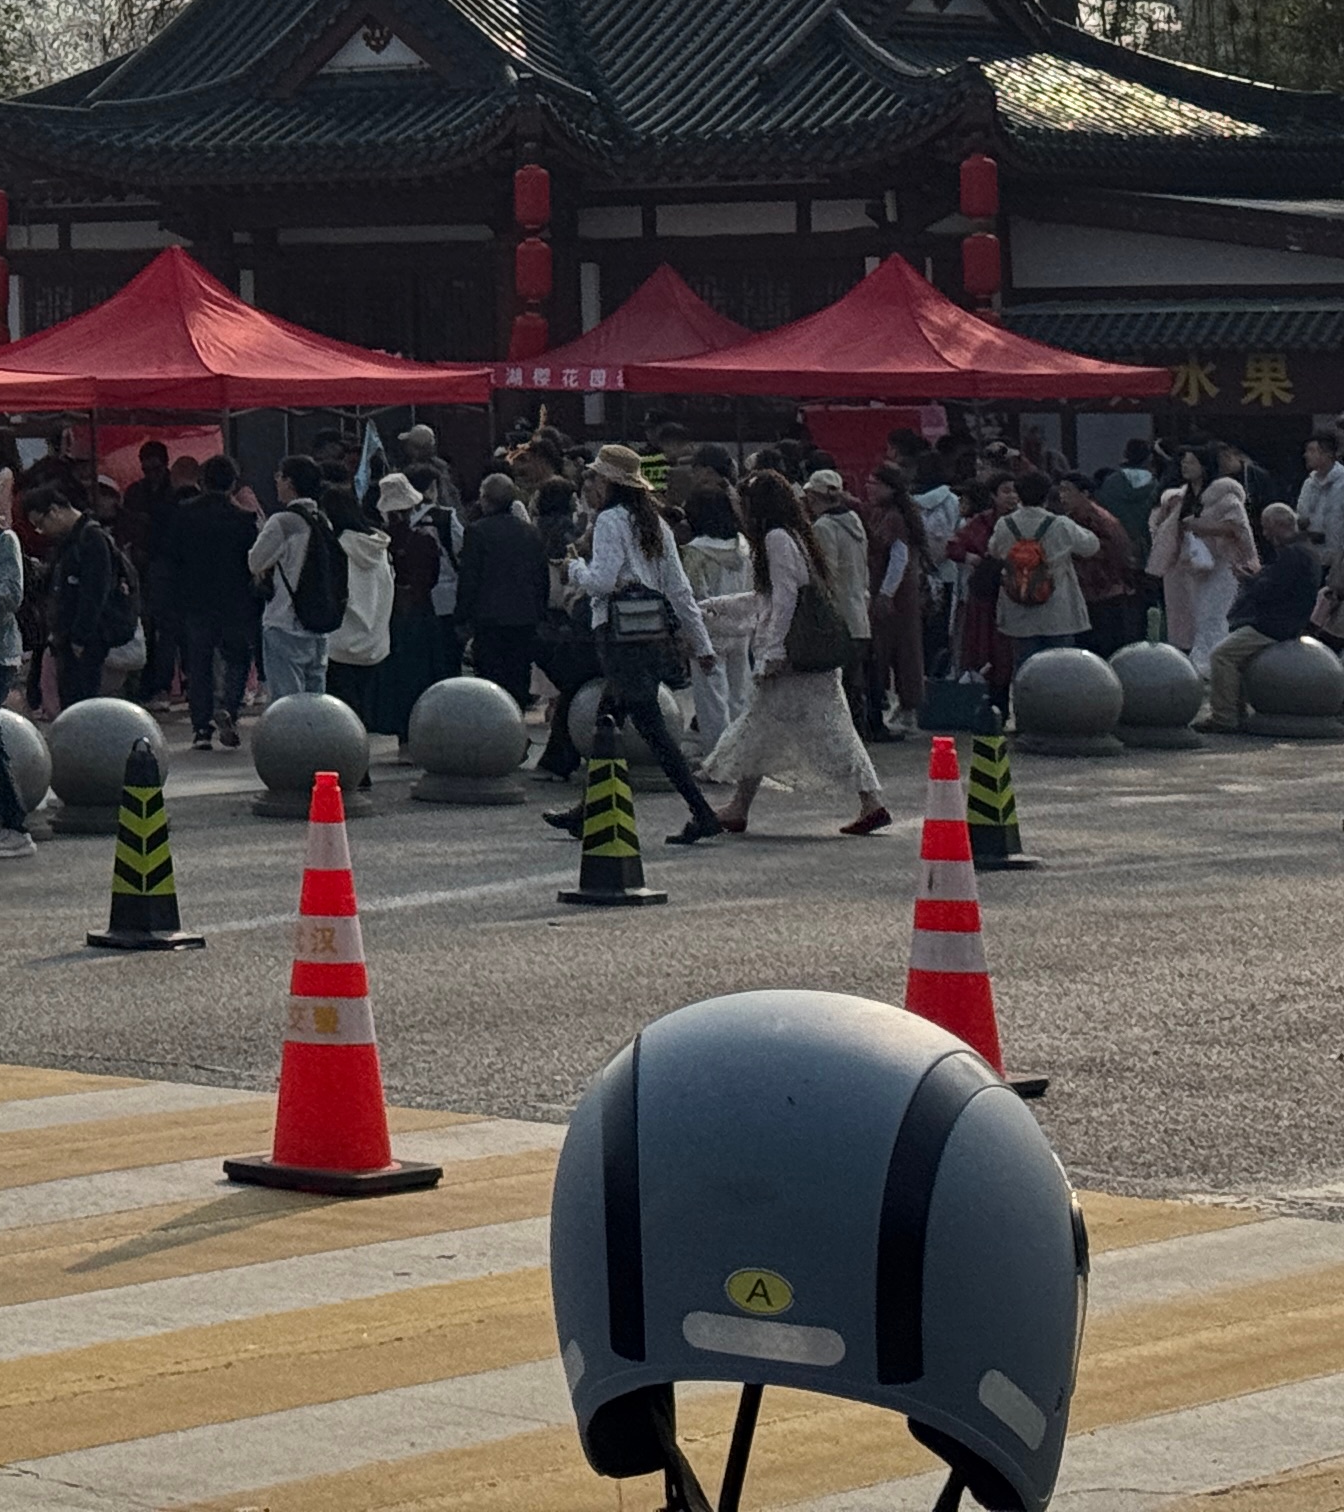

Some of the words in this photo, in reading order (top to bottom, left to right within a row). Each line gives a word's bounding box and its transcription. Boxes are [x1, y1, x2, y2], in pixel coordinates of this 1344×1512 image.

[490, 366, 624, 388] 湖樱花园
[1169, 353, 1296, 407] 水果
[745, 1278, 774, 1307] A
